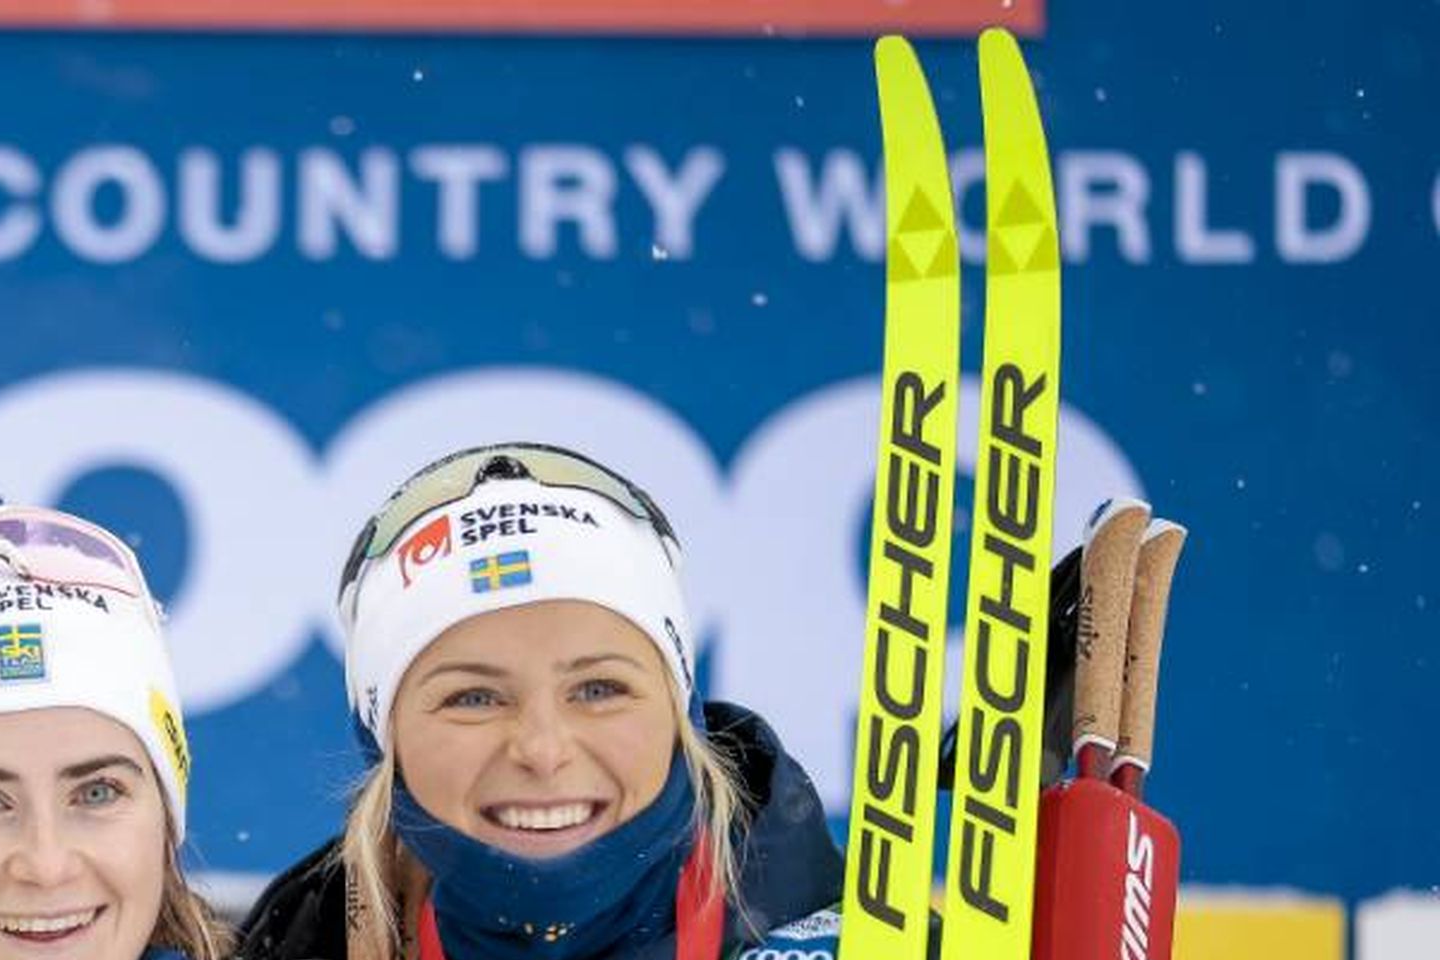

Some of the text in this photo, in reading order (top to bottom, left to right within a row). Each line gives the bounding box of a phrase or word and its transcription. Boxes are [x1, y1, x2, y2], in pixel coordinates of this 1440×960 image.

[774, 148, 1372, 264] WRLD
[459, 503, 599, 528] SVENSKA
[461, 519, 537, 546] SPEL
[859, 371, 946, 930] FISCHER
[960, 362, 1047, 922] FISCHER
